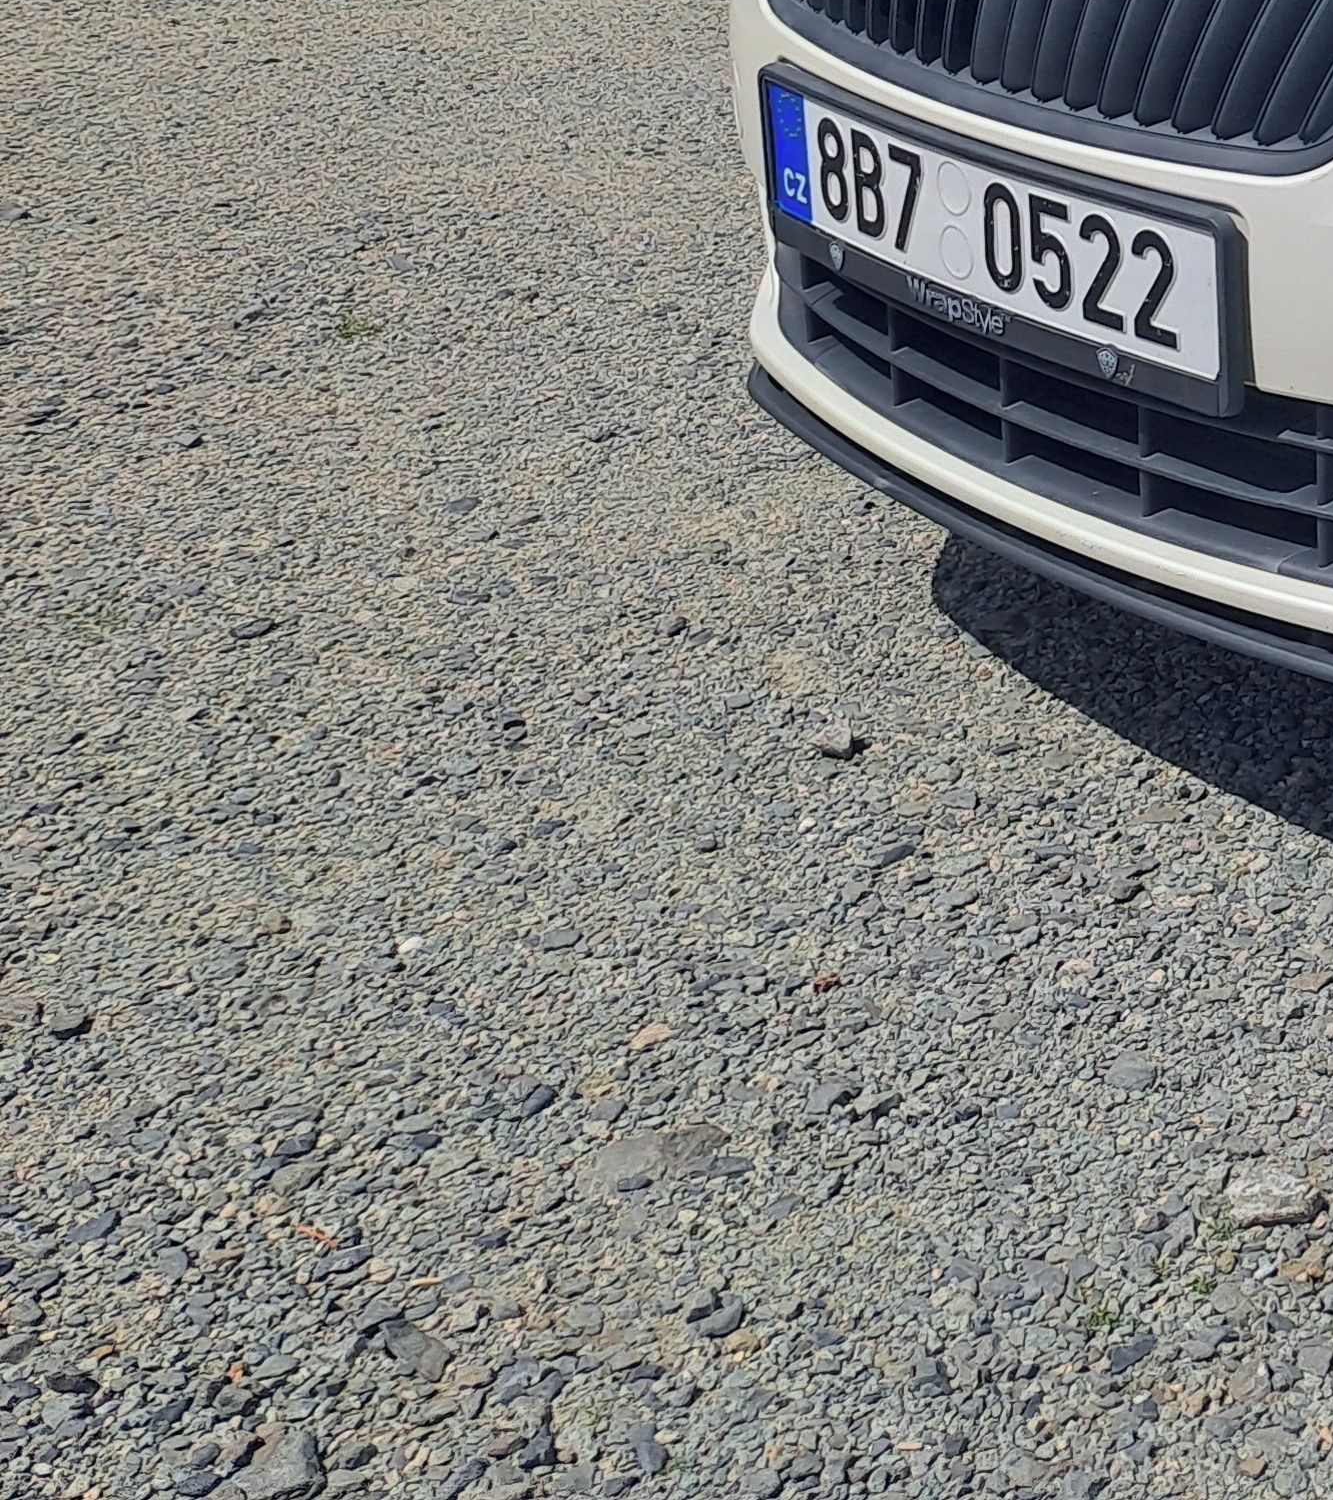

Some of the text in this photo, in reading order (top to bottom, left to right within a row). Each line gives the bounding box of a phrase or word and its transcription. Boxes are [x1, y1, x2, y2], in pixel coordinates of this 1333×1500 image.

[783, 166, 808, 204] CZ
[818, 117, 1178, 351] 8B7 0522
